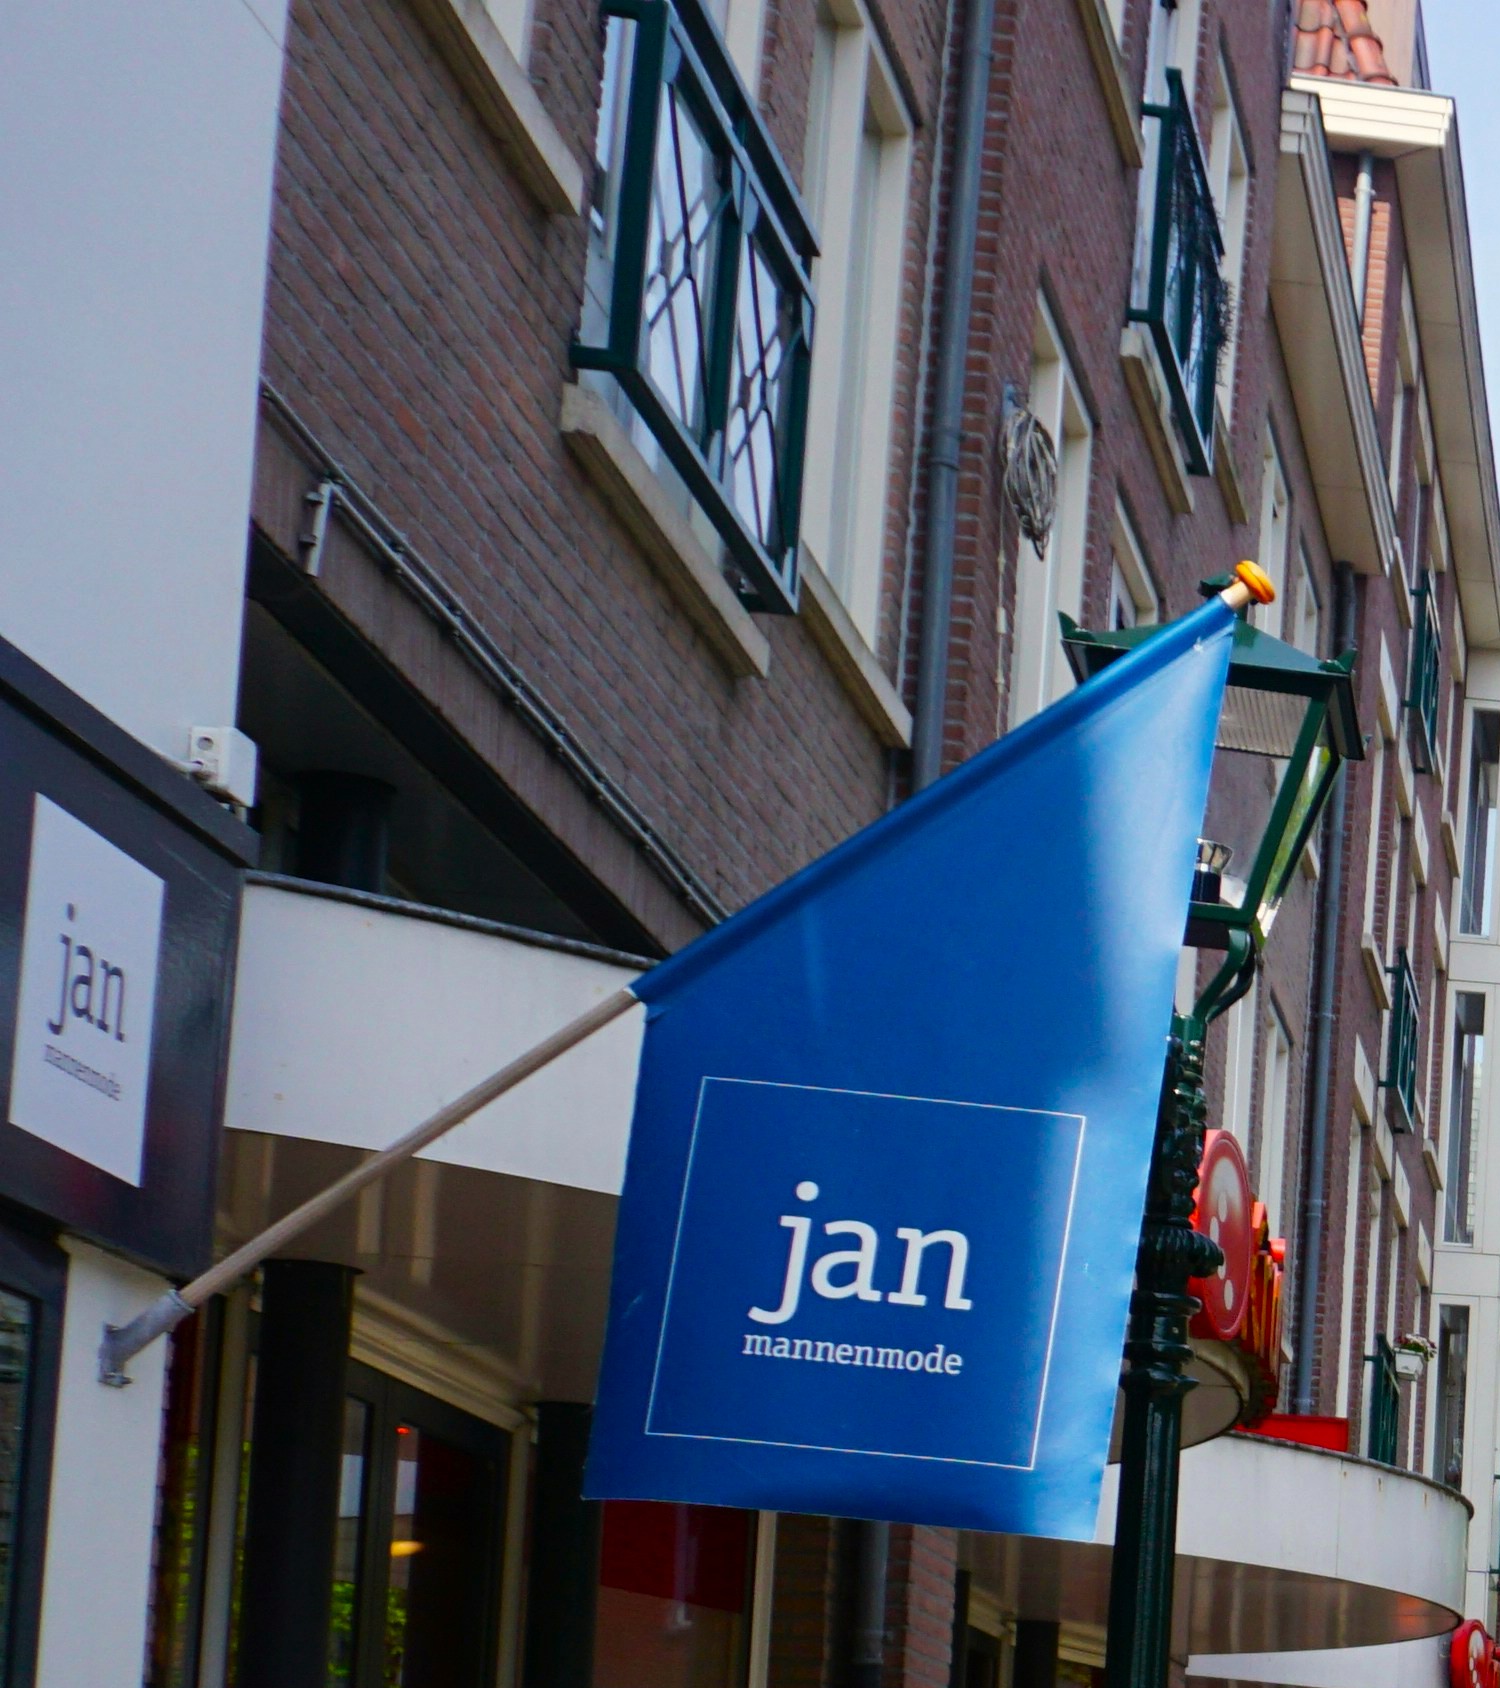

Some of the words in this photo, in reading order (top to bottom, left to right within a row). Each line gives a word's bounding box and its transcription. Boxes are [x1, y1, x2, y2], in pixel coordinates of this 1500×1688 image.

[48, 903, 127, 1043] jan
[748, 1181, 973, 1325] jan
[742, 1331, 964, 1377] mannenmode
